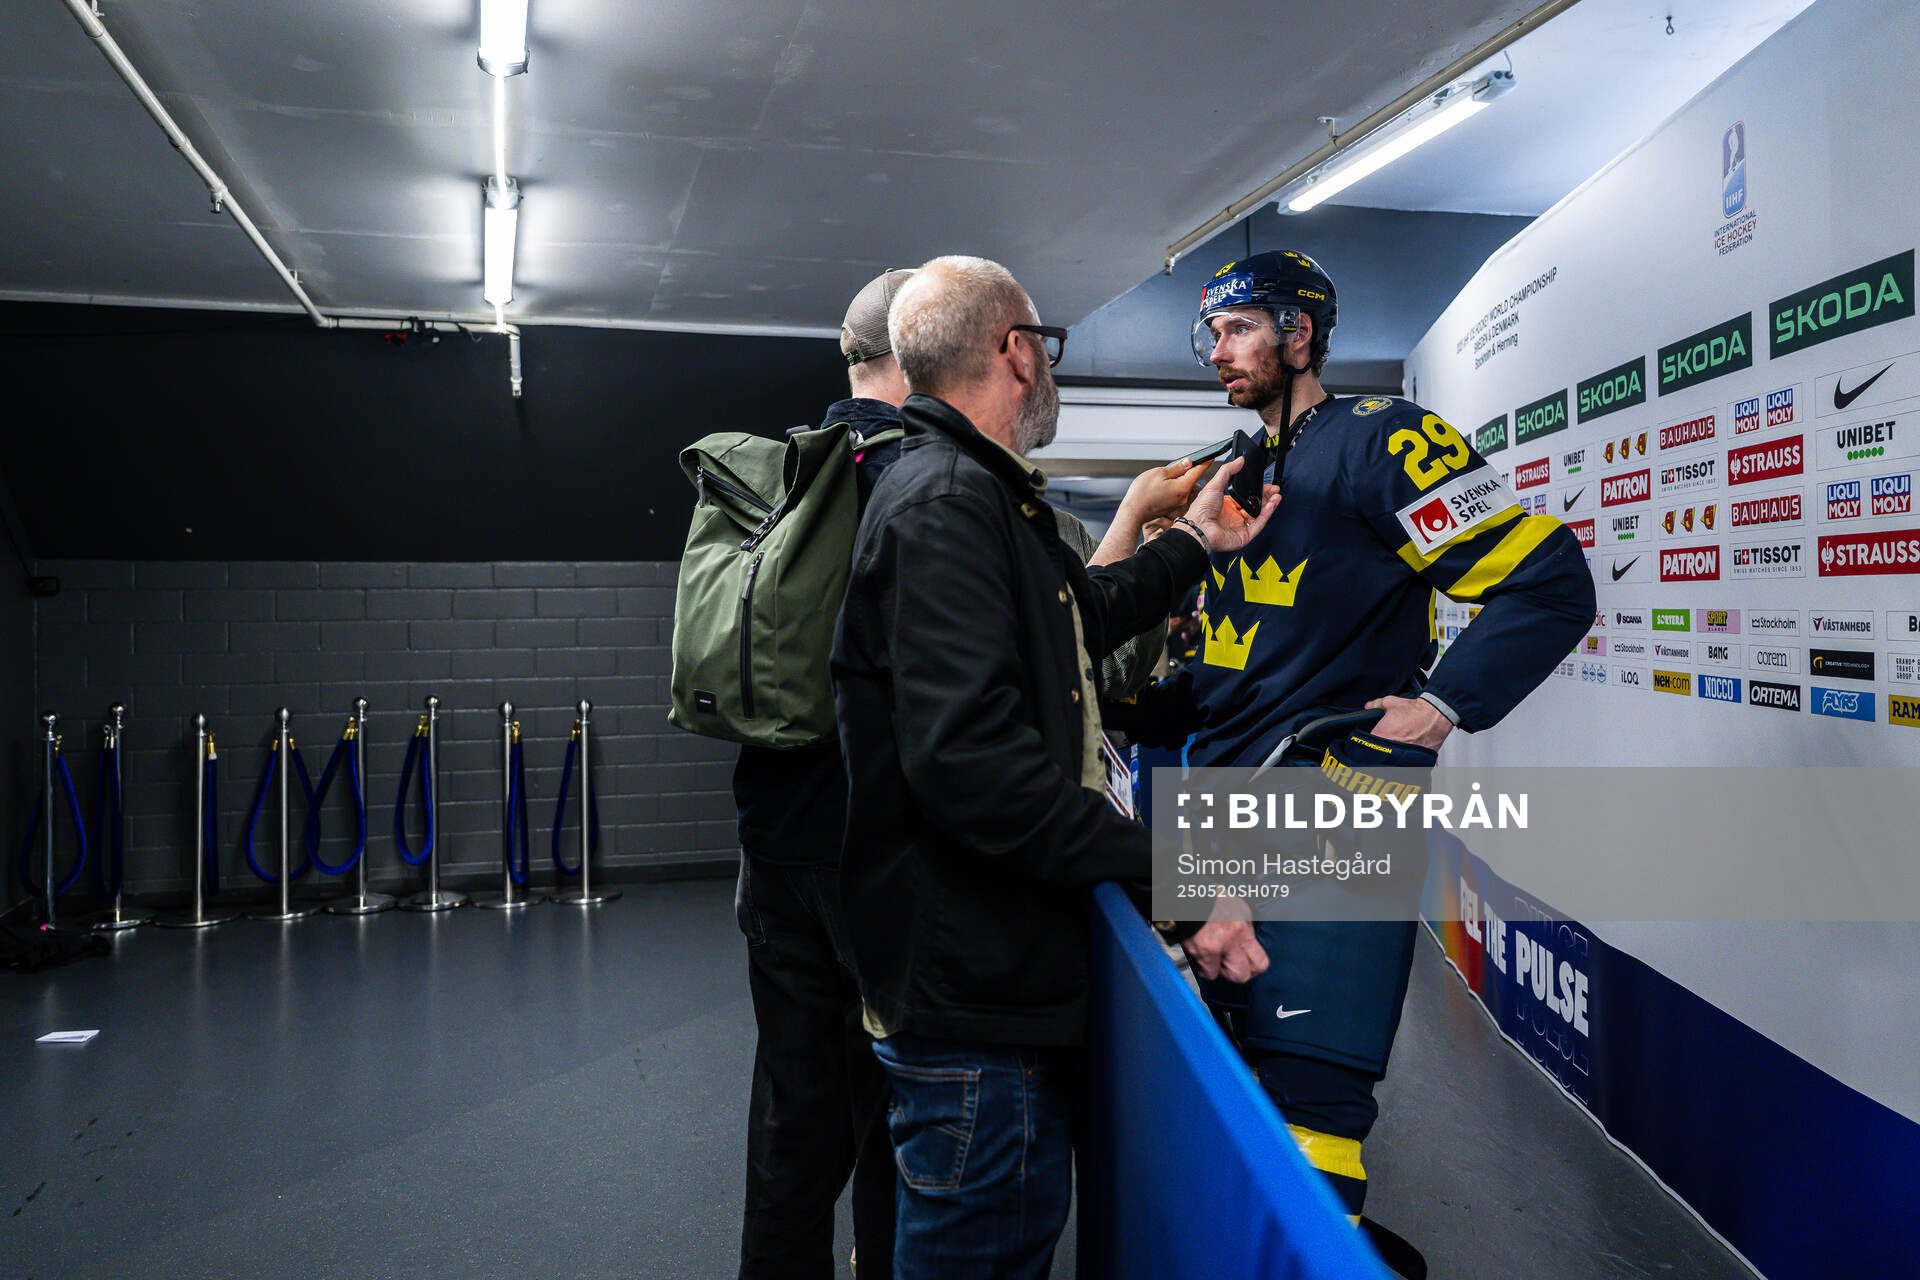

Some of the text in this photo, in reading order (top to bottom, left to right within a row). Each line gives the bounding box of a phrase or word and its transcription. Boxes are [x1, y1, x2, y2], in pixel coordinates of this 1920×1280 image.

[1725, 188, 1743, 208] IIHF
[1714, 210, 1757, 238] INTERNATIONAL
[1714, 219, 1757, 250] ICE HOCKEY
[1719, 233, 1753, 256] FEDERATION
[1206, 279, 1247, 296] SVENSKA
[1297, 289, 1325, 301] CCM
[1490, 299, 1508, 321] WORLD
[1509, 266, 1557, 309] CHAMPIONSHIP
[1491, 311, 1519, 338] DENMARK
[1497, 333, 1518, 352] Herning
[1735, 400, 1759, 417] LIQUI
[1767, 390, 1792, 410] LIQUI
[1736, 415, 1760, 433] MOLY
[1767, 406, 1793, 425] MOLY
[1660, 416, 1715, 449] BAUHAUS
[1837, 421, 1896, 449] UNIBET
[1388, 413, 1470, 491] 29
[1564, 450, 1585, 467] UNIBET
[1742, 445, 1801, 475] STRAUSS
[1521, 464, 1550, 484] STRAUSS
[1676, 460, 1715, 481] TISSOT
[1451, 479, 1502, 510] SVENSKA
[1603, 474, 1648, 501] PATRON
[1828, 482, 1859, 502] LIQUI
[1872, 476, 1911, 496] LIQUI
[1458, 500, 1492, 523] SPEL
[1732, 497, 1801, 524] BAUHAUS
[1829, 501, 1860, 518] MOLY
[1872, 495, 1911, 514] MOLY
[1612, 515, 1640, 532] UNIBET
[1751, 545, 1800, 564] TISSOT
[1836, 539, 1920, 568] STRAUSS
[1663, 551, 1716, 577] PATRON
[1622, 616, 1642, 624] SCANIA
[1707, 611, 1728, 626] SPORT
[1760, 617, 1796, 630] Stockholm
[1823, 618, 1871, 632] VÄSTANHEDE
[1621, 643, 1644, 653] Stockholm
[1708, 646, 1728, 660] BANG
[1757, 651, 1788, 667] corem
[1705, 676, 1734, 701] NOCCO
[1751, 686, 1799, 708] ORTEMA
[1484, 900, 1507, 975] THE
[1515, 930, 1589, 1038] PULSE
